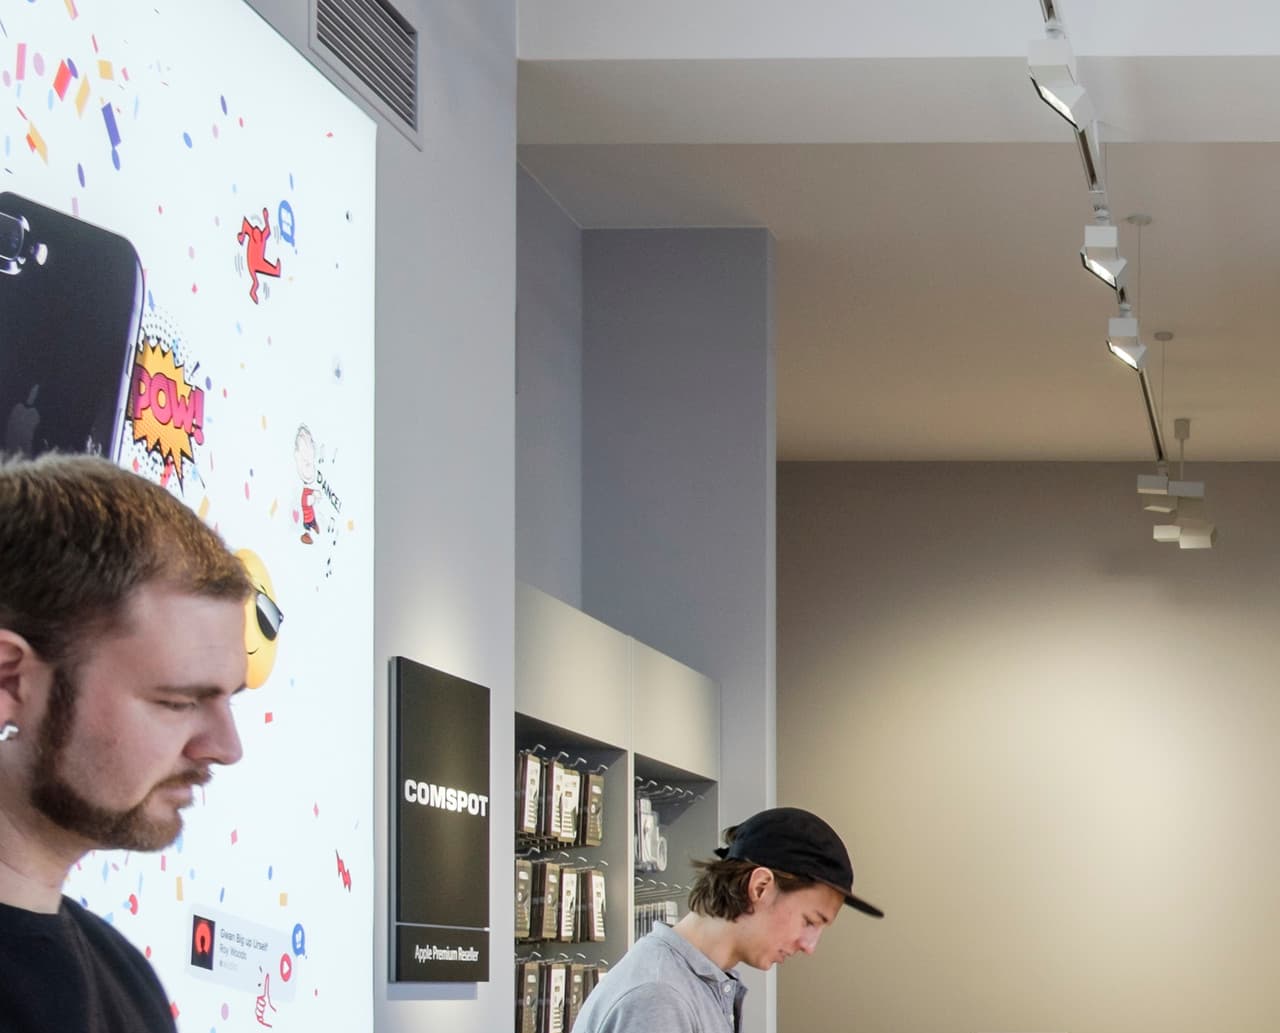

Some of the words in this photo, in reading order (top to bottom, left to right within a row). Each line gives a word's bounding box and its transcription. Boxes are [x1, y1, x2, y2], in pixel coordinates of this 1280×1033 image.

[133, 363, 204, 446] POW!
[317, 470, 342, 513] DANCE!
[404, 779, 489, 817] COMSPOT
[414, 944, 433, 964] Apple
[433, 945, 458, 961] Premium
[458, 946, 479, 962] Reseller
